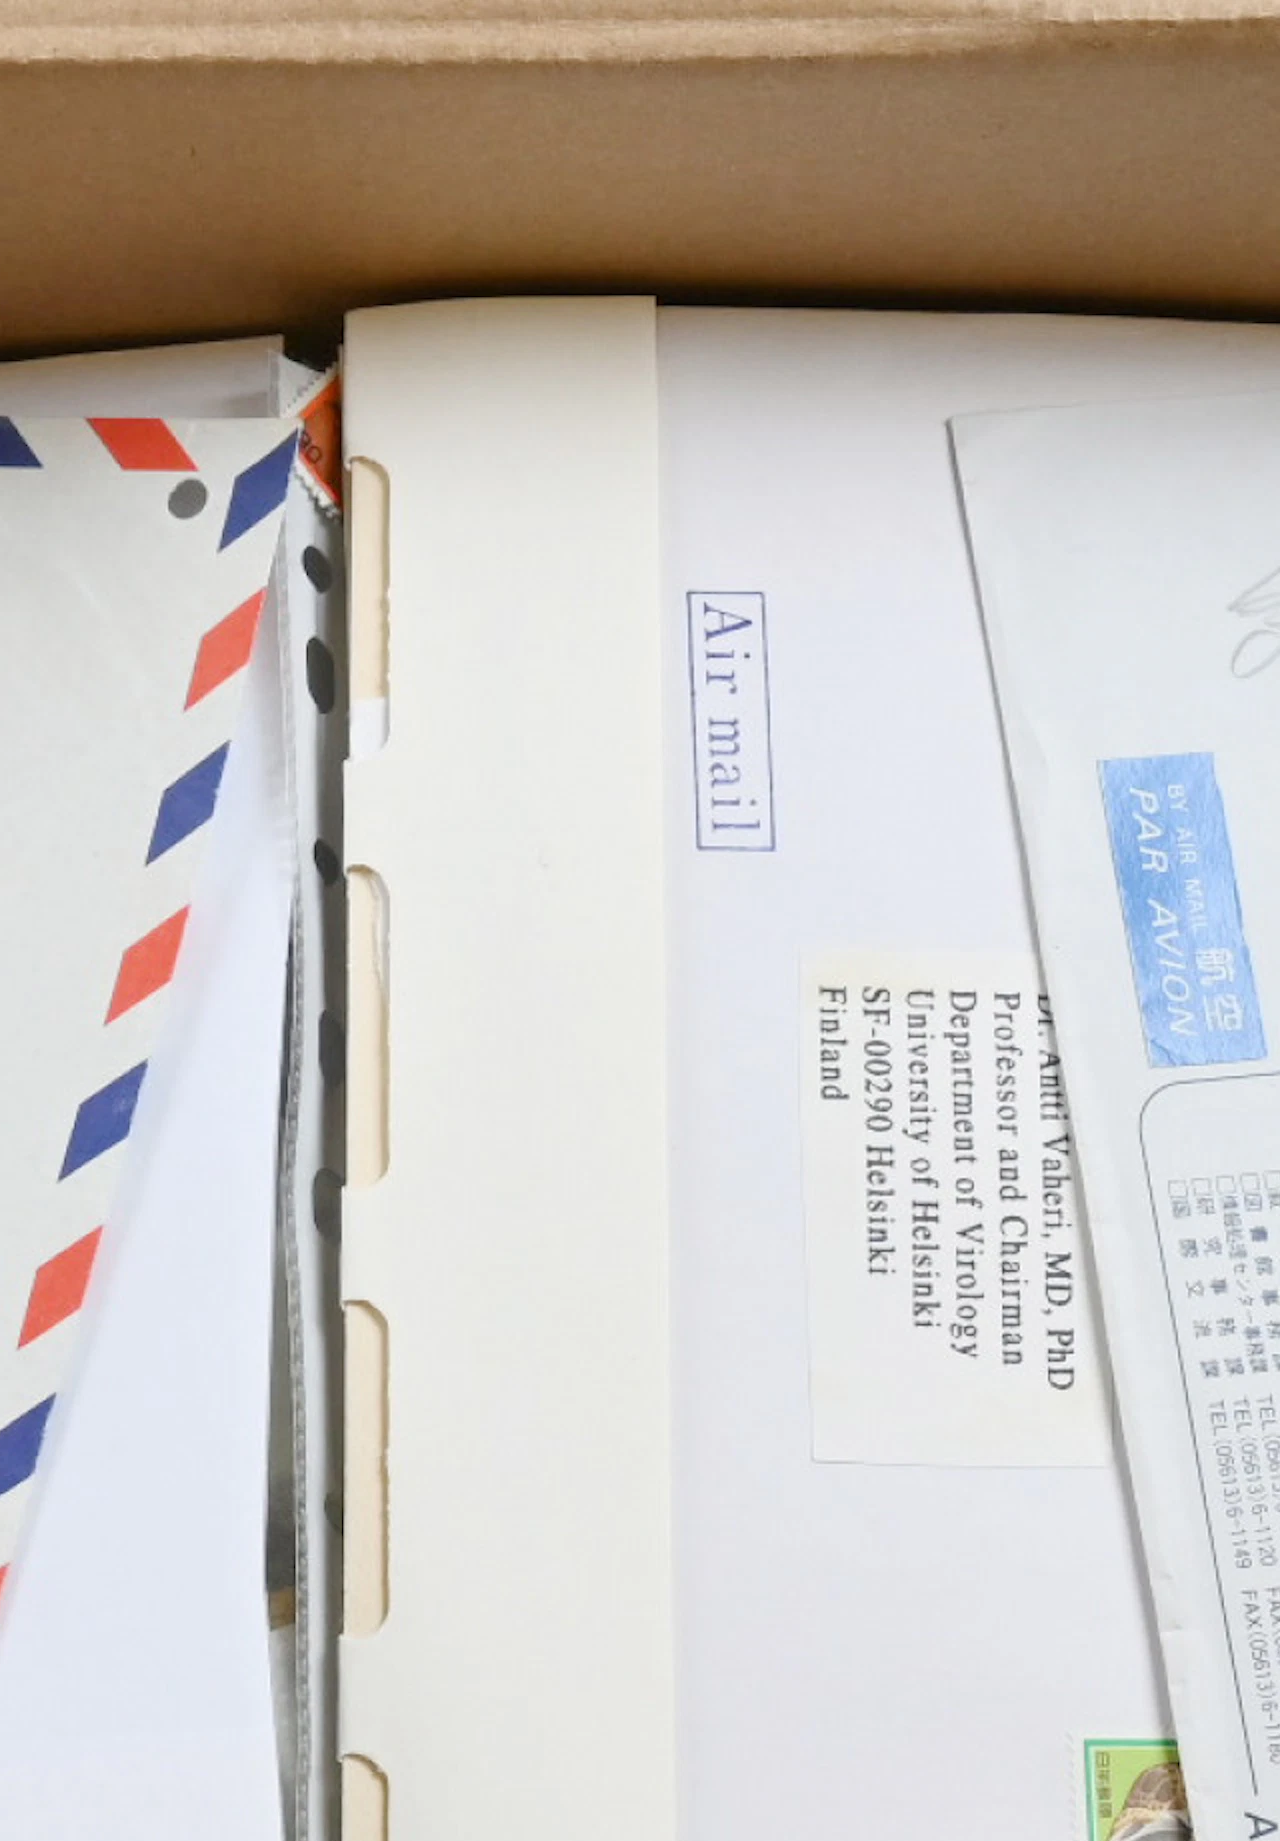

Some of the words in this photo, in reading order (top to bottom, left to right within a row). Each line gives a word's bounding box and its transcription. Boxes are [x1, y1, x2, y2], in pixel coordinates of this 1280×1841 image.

[701, 602, 753, 695] Air
[706, 716, 761, 834] mail
[1164, 783, 1188, 813] BY
[1128, 786, 1169, 874] PAR
[1172, 827, 1199, 866] AIR
[1181, 877, 1209, 932] MAIL
[1145, 897, 1198, 1039] AVION
[1194, 947, 1245, 1033] 航空
[816, 985, 849, 1102] Finland
[860, 985, 893, 1132] SF-00290
[903, 988, 938, 1143] University
[945, 989, 982, 1165] Department
[991, 991, 1025, 1137] Professor
[864, 1144, 896, 1277] Helsinki
[909, 1157, 939, 1191] of
[952, 1176, 983, 1211] of
[998, 1147, 1028, 1202] and
[908, 1200, 942, 1330] Helsinki
[949, 1221, 986, 1360] Virology
[998, 1214, 1031, 1367] Chairman
[1042, 1251, 1074, 1316] MD,
[1046, 1328, 1076, 1391] PhD
